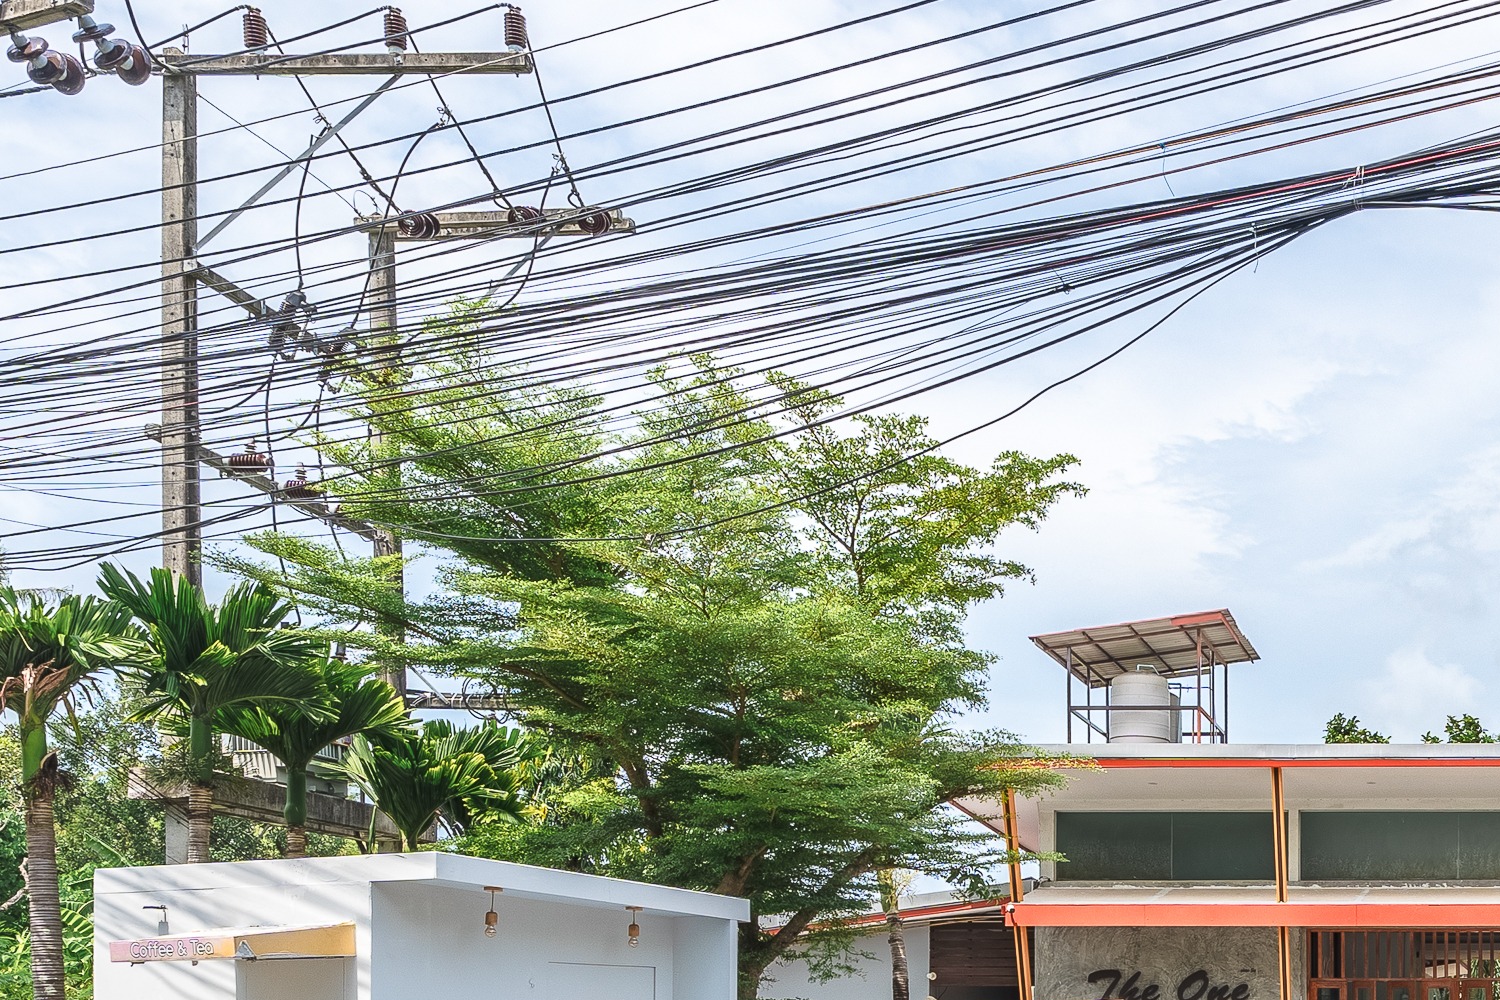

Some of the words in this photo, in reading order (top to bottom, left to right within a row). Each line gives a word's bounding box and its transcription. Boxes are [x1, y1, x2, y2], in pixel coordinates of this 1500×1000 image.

[130, 940, 174, 958] Coffee
[177, 939, 188, 956] &
[189, 939, 214, 955] Tea
